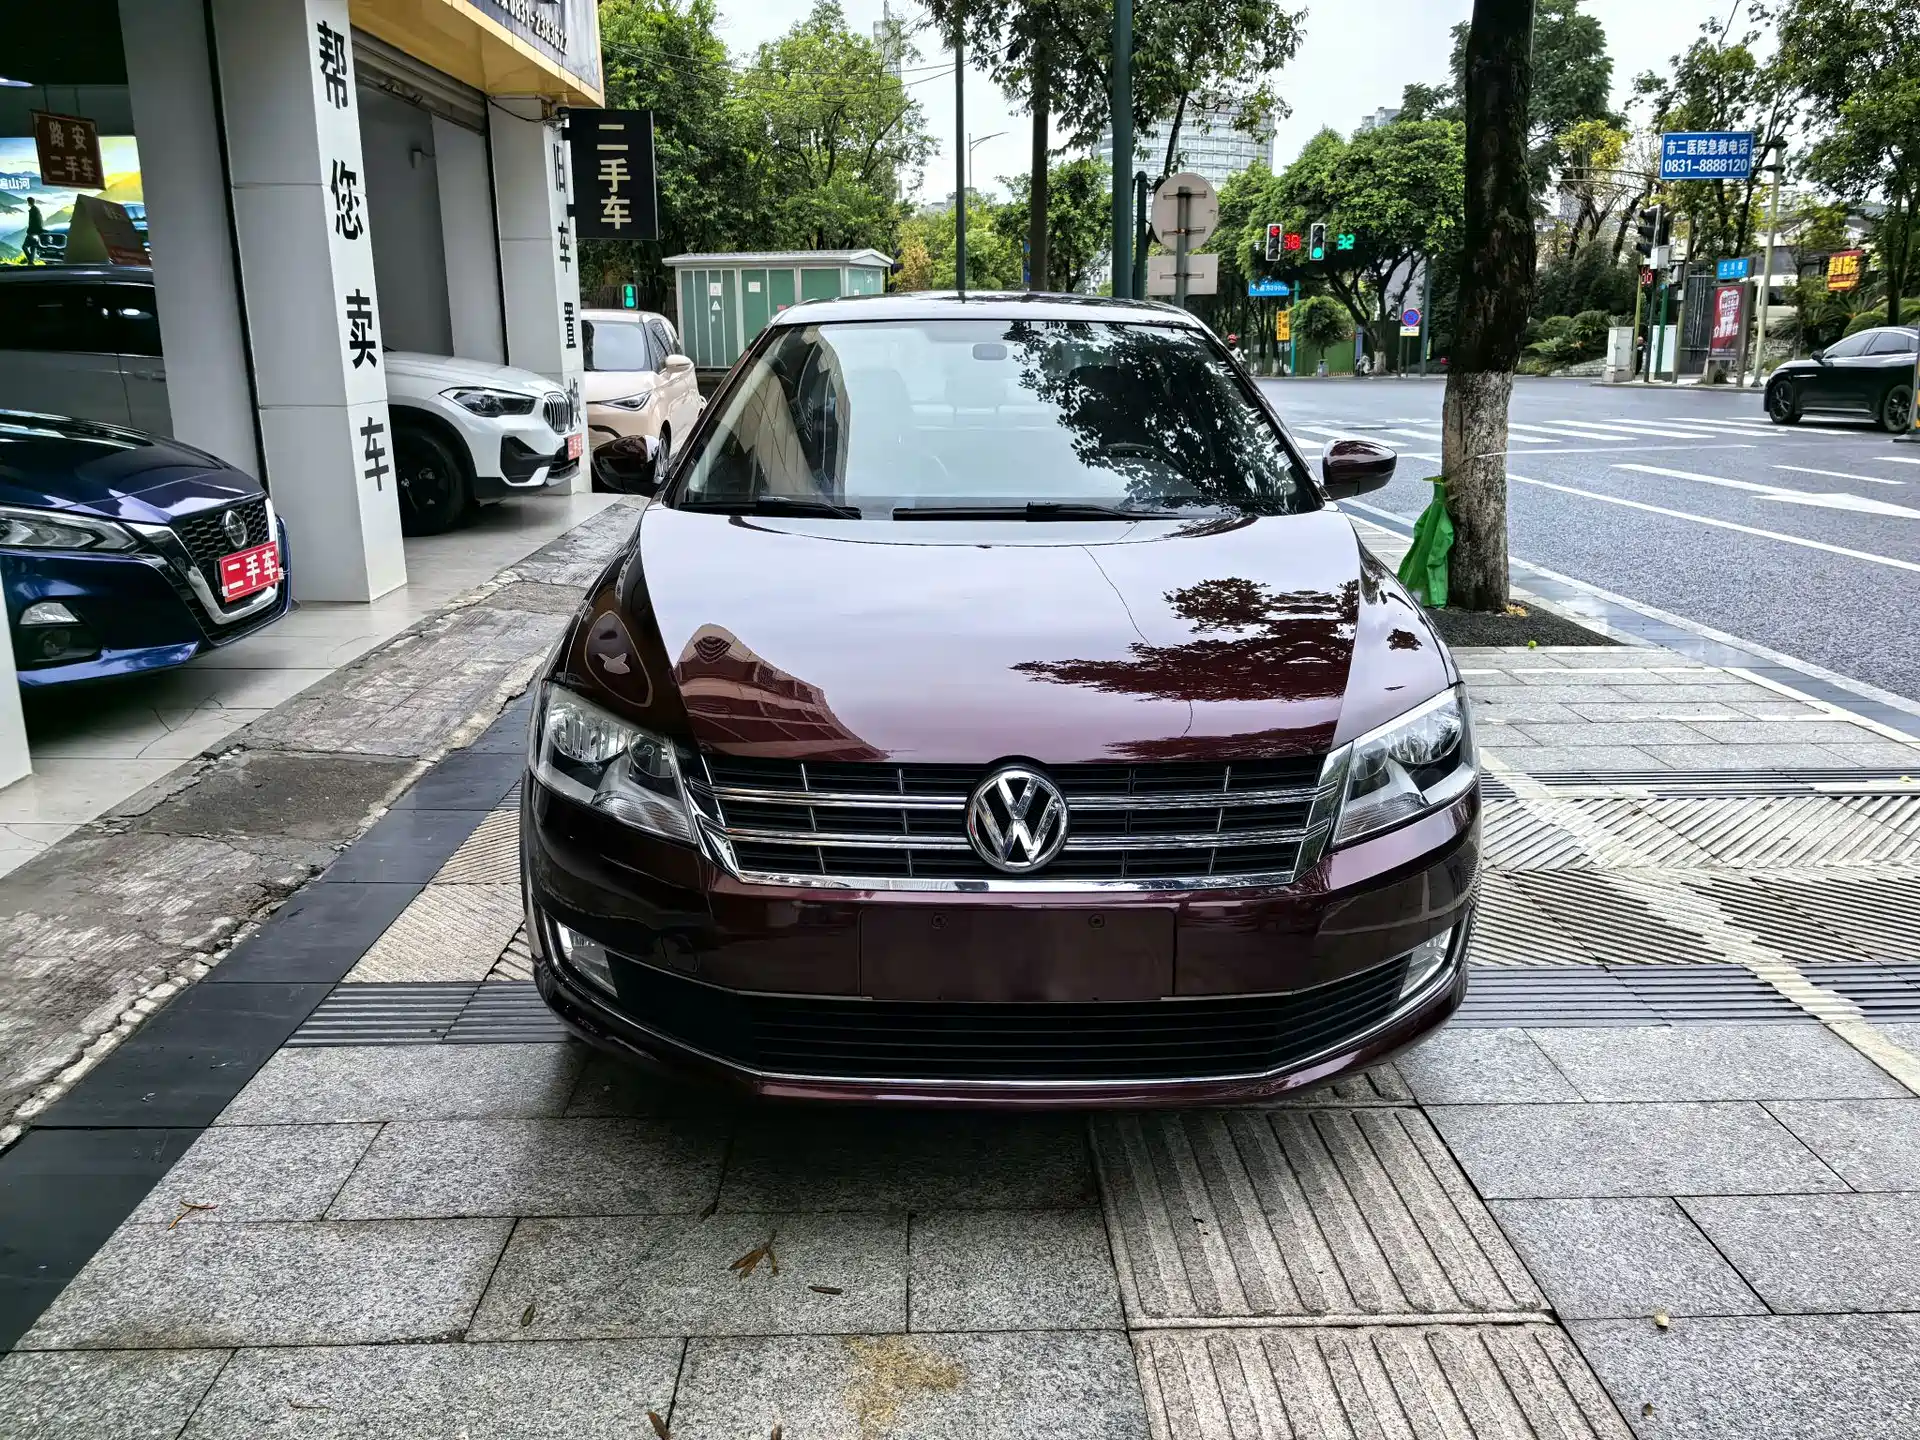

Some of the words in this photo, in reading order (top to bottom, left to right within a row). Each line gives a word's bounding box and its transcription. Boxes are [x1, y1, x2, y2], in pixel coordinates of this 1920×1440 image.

[49, 121, 87, 150] 路安
[1667, 139, 1749, 155] 市二医院急救电话
[50, 155, 95, 181] 二手车
[597, 124, 632, 230] 二手车
[1664, 159, 1748, 173] 0831-8888120
[1337, 233, 1355, 250] 32
[316, 20, 390, 492] 帮您卖车
[227, 549, 277, 590] 二手车
